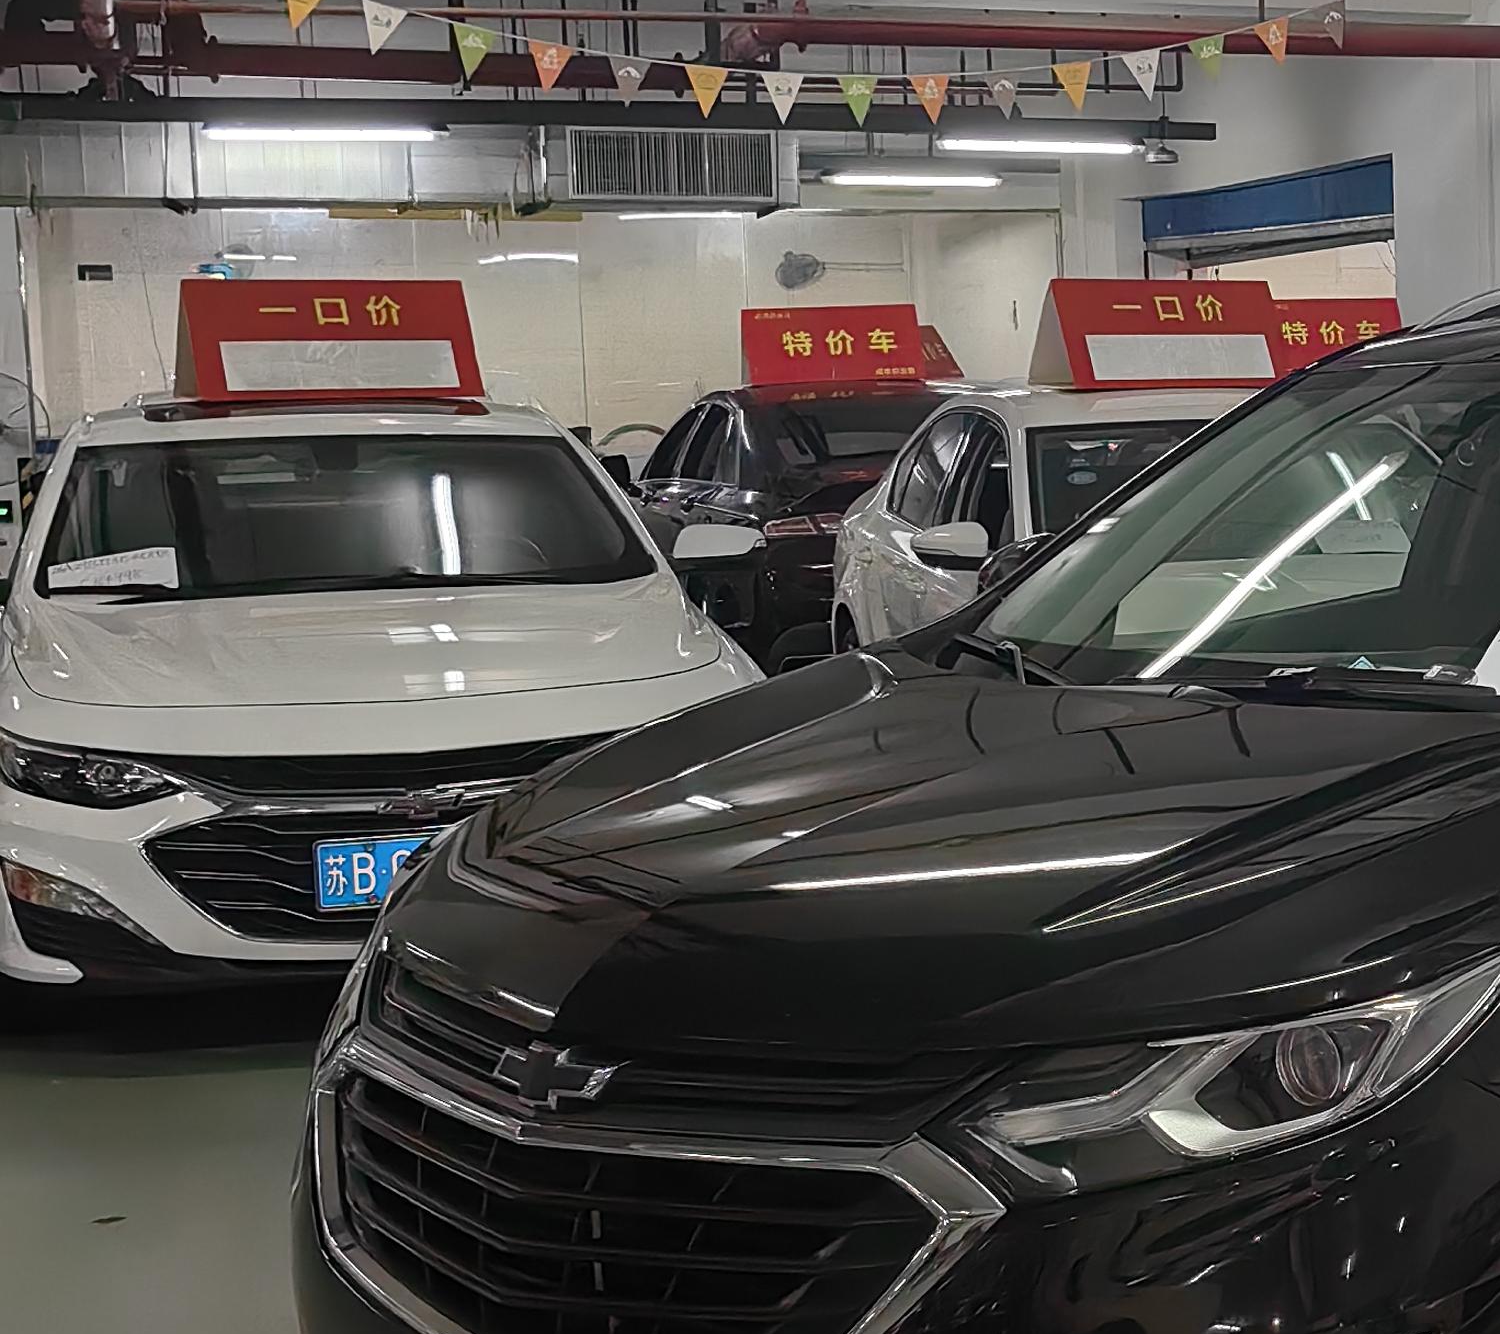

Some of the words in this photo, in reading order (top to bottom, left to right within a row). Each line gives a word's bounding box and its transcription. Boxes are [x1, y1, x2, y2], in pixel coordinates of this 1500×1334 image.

[258, 295, 401, 326] 一口价
[1112, 294, 1224, 322] 一口价
[781, 327, 899, 358] 特价车
[1281, 320, 1381, 347] 特价车
